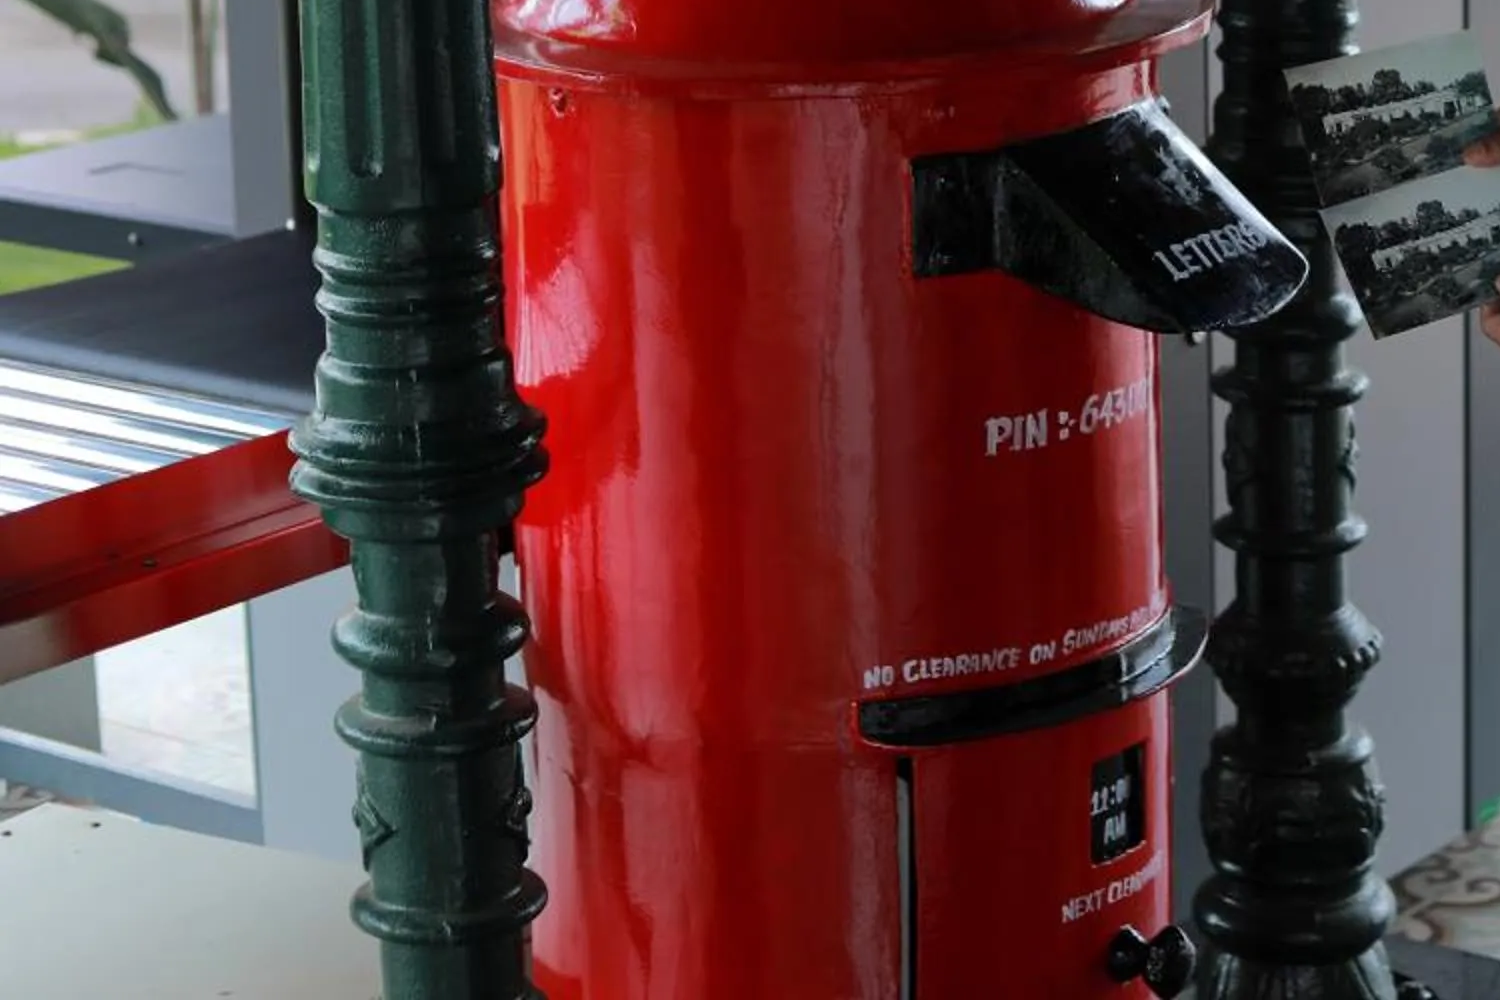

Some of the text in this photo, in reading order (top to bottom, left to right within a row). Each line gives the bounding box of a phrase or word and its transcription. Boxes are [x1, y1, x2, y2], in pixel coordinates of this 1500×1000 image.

[1152, 220, 1268, 283] LETTERS
[985, 408, 1049, 457] PIN
[863, 663, 894, 690] NO
[902, 647, 1021, 684] CLEARANCE
[1030, 639, 1056, 665] ON
[1103, 810, 1127, 846] AM
[1060, 887, 1106, 924] NEXT
